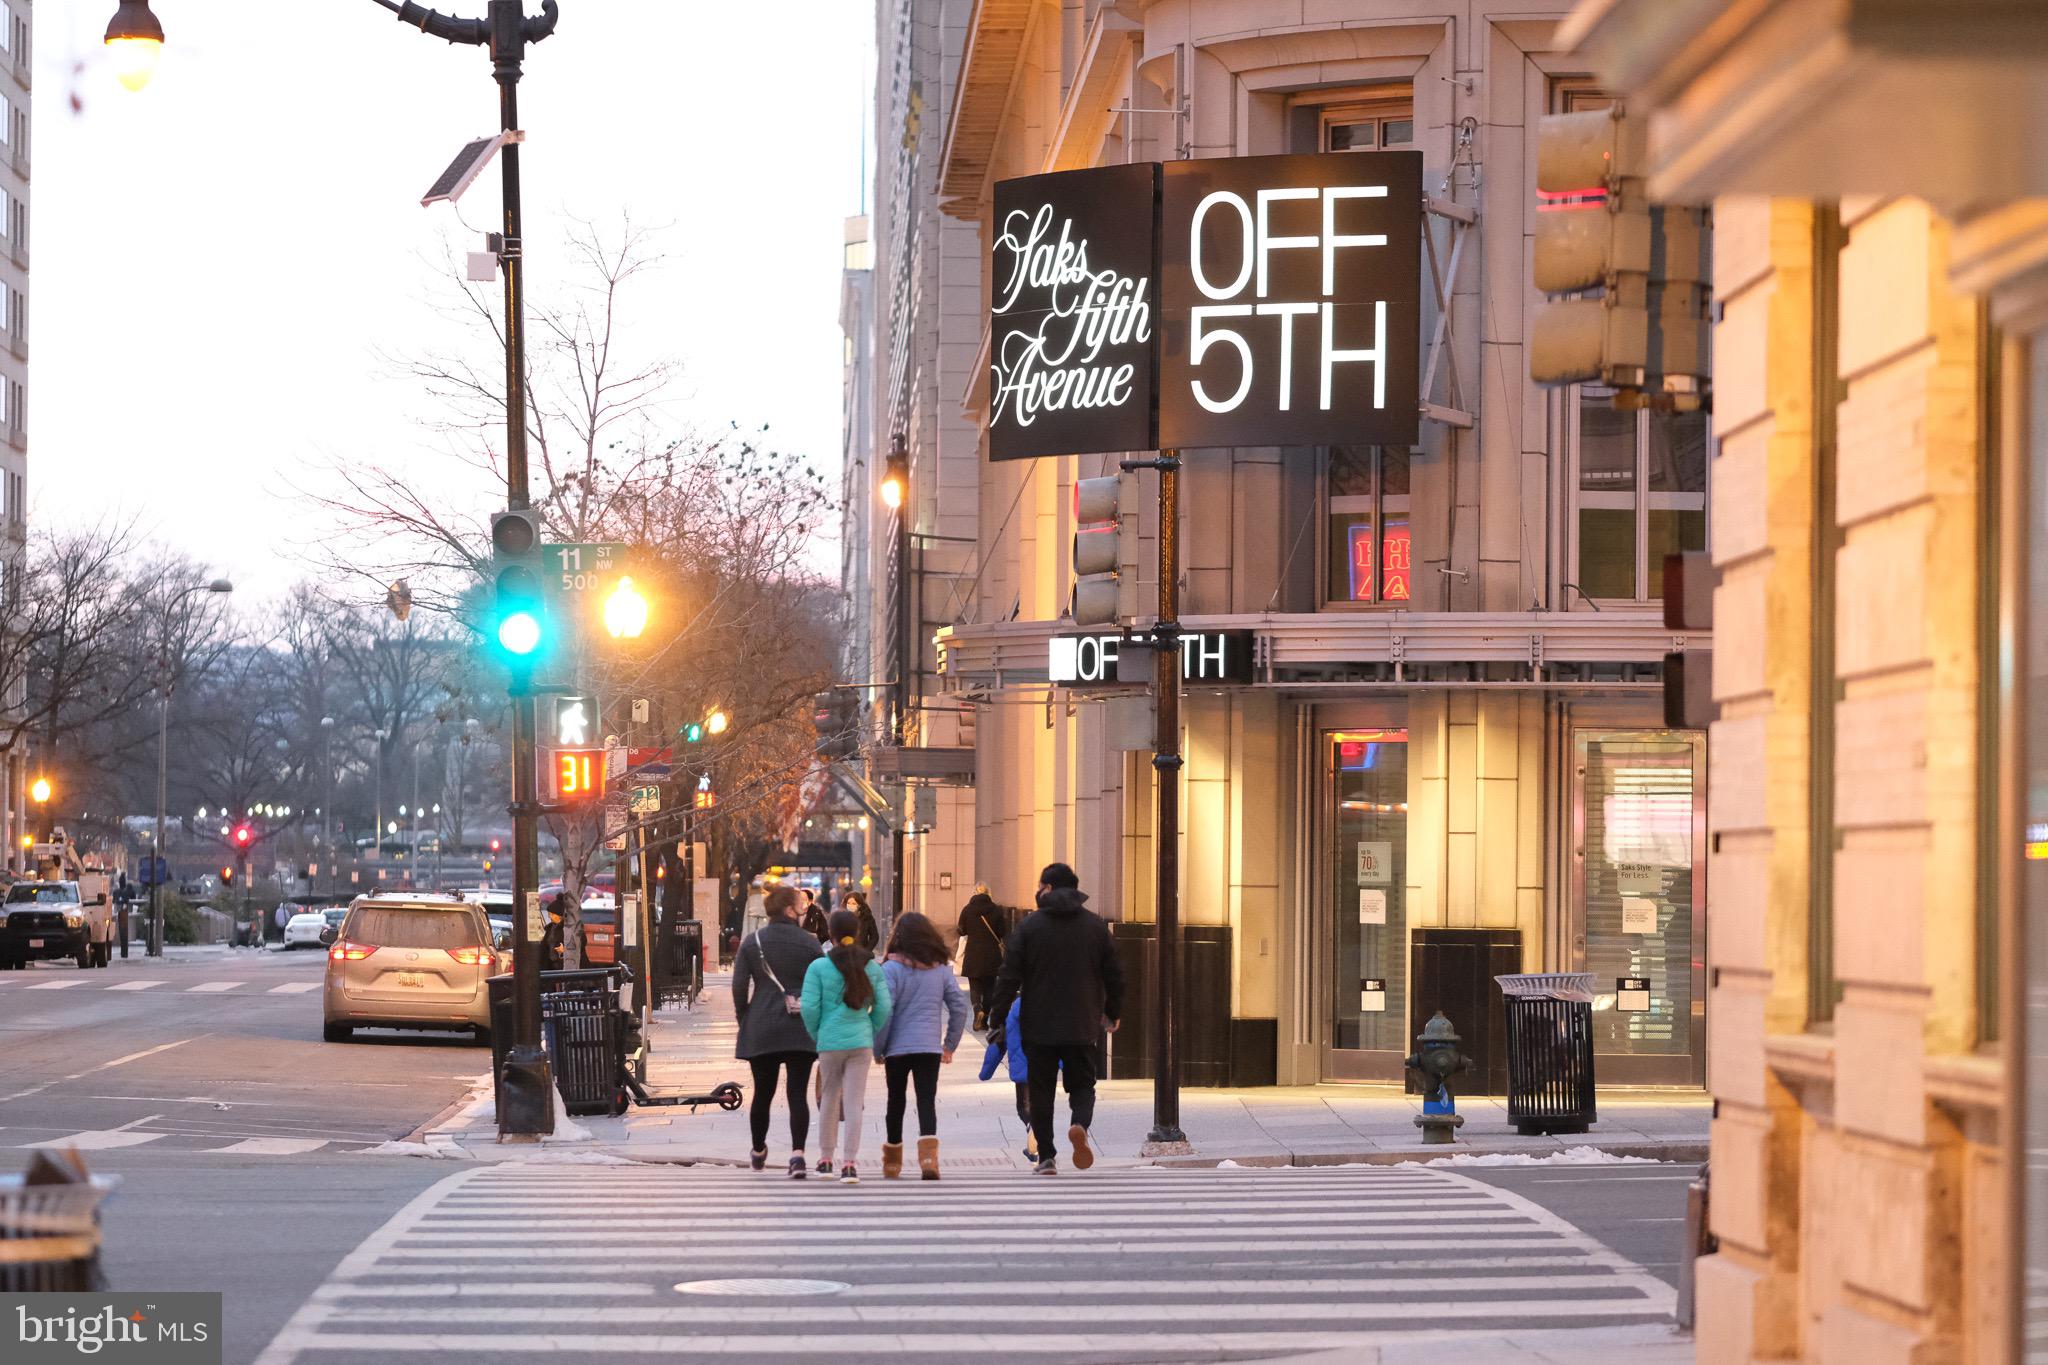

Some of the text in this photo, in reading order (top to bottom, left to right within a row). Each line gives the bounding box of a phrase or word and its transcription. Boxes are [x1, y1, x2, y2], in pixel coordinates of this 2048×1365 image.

[991, 203, 1088, 315] Saks
[1189, 185, 1389, 301] OFF
[1189, 300, 1387, 414] 5TH
[989, 330, 1135, 428] Avenue
[557, 546, 613, 570] 11 ST
[596, 560, 613, 570] NW
[562, 574, 599, 590] 500
[561, 755, 591, 791] 31
[1637, 864, 1651, 872] Style
